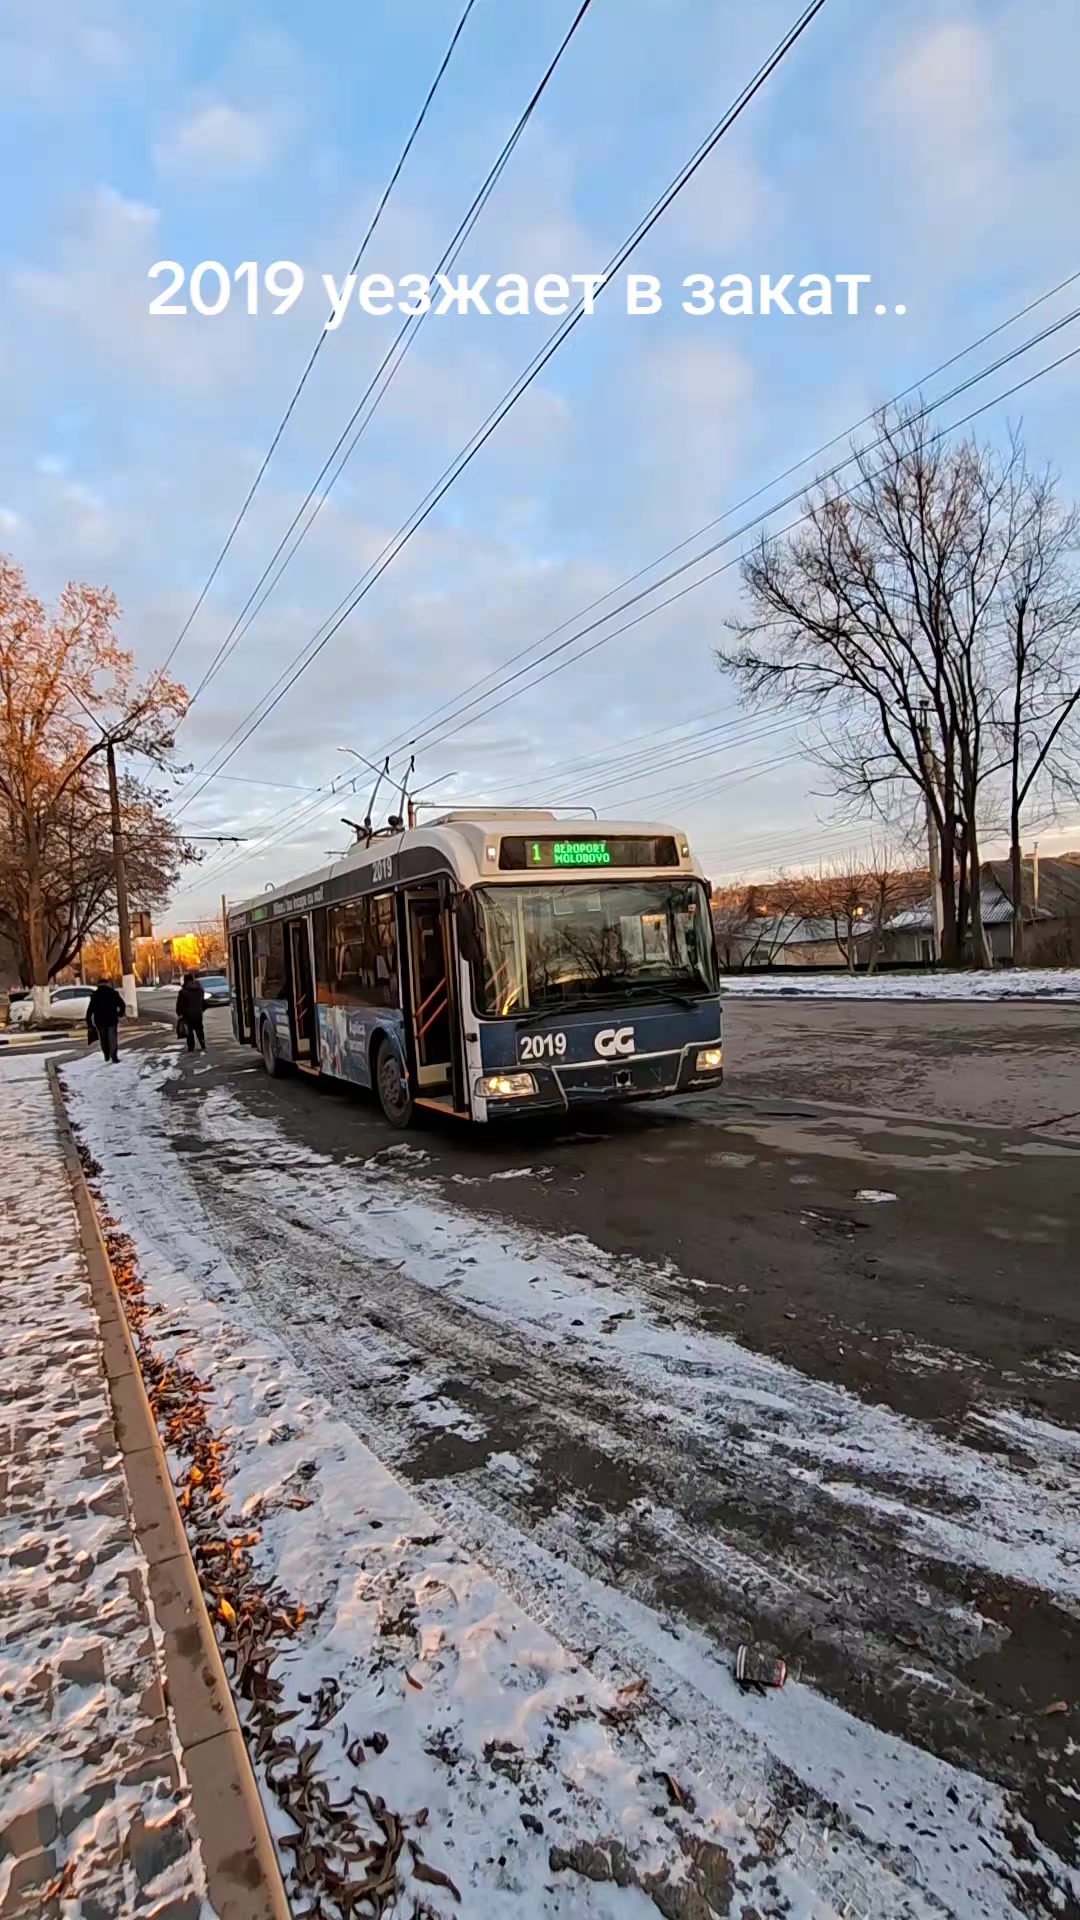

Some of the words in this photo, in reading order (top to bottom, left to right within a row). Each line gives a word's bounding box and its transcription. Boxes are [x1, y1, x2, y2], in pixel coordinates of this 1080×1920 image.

[532, 843, 541, 861] 1
[554, 843, 606, 854] AEROPORT
[554, 853, 610, 863] MOLODOVO
[372, 856, 393, 883] 2019
[520, 1031, 567, 1060] 2019
